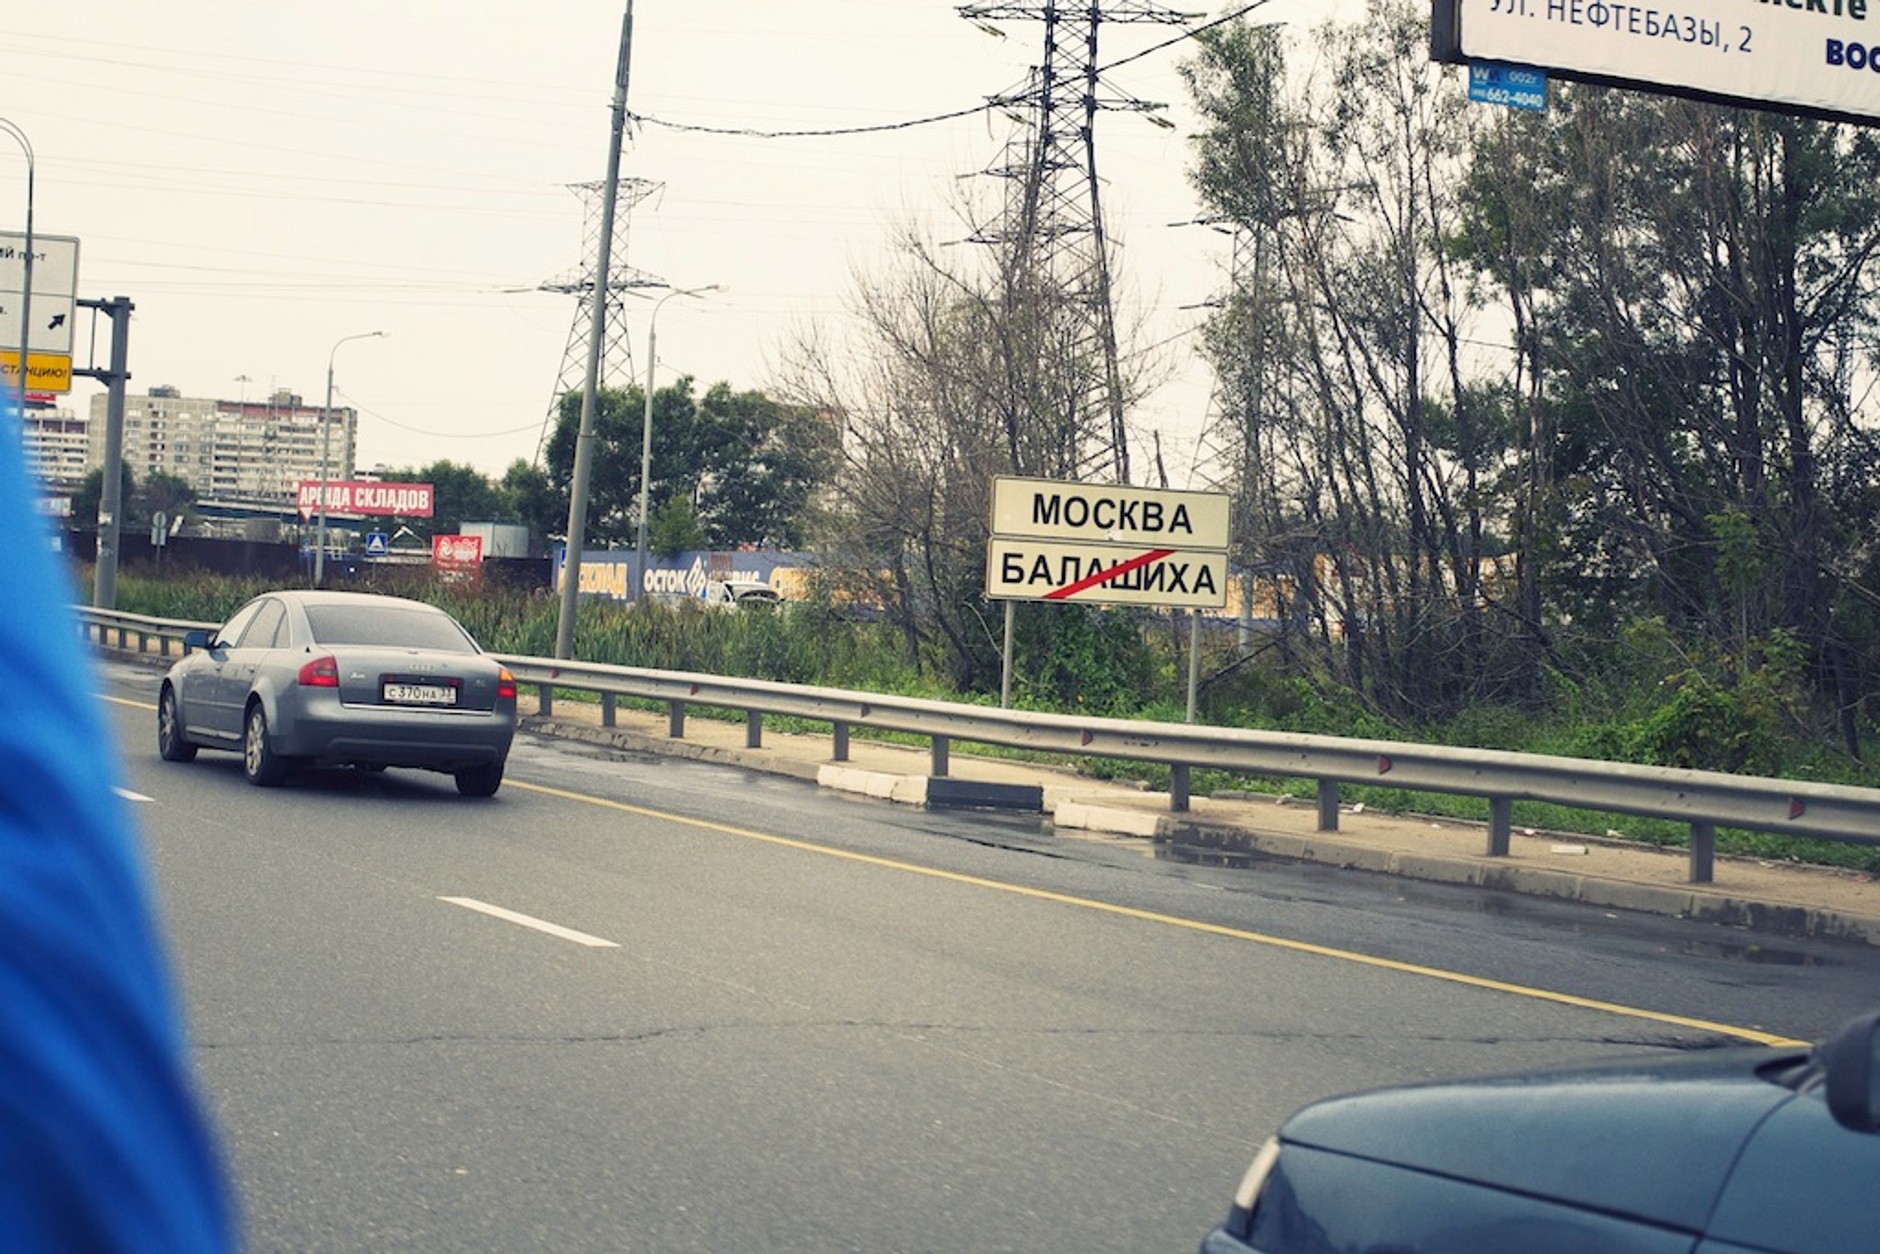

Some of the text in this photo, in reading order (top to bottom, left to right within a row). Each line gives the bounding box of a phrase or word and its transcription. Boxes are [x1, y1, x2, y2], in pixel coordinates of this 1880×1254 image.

[1547, 0, 1730, 53] НЕФТЕБАЗЫ,
[1738, 25, 1753, 52] 2
[299, 486, 429, 514] АРЕНДА СКЛАДОВ
[1032, 493, 1193, 534] МОСКВА
[1001, 552, 1217, 595] БАЛАШИХА
